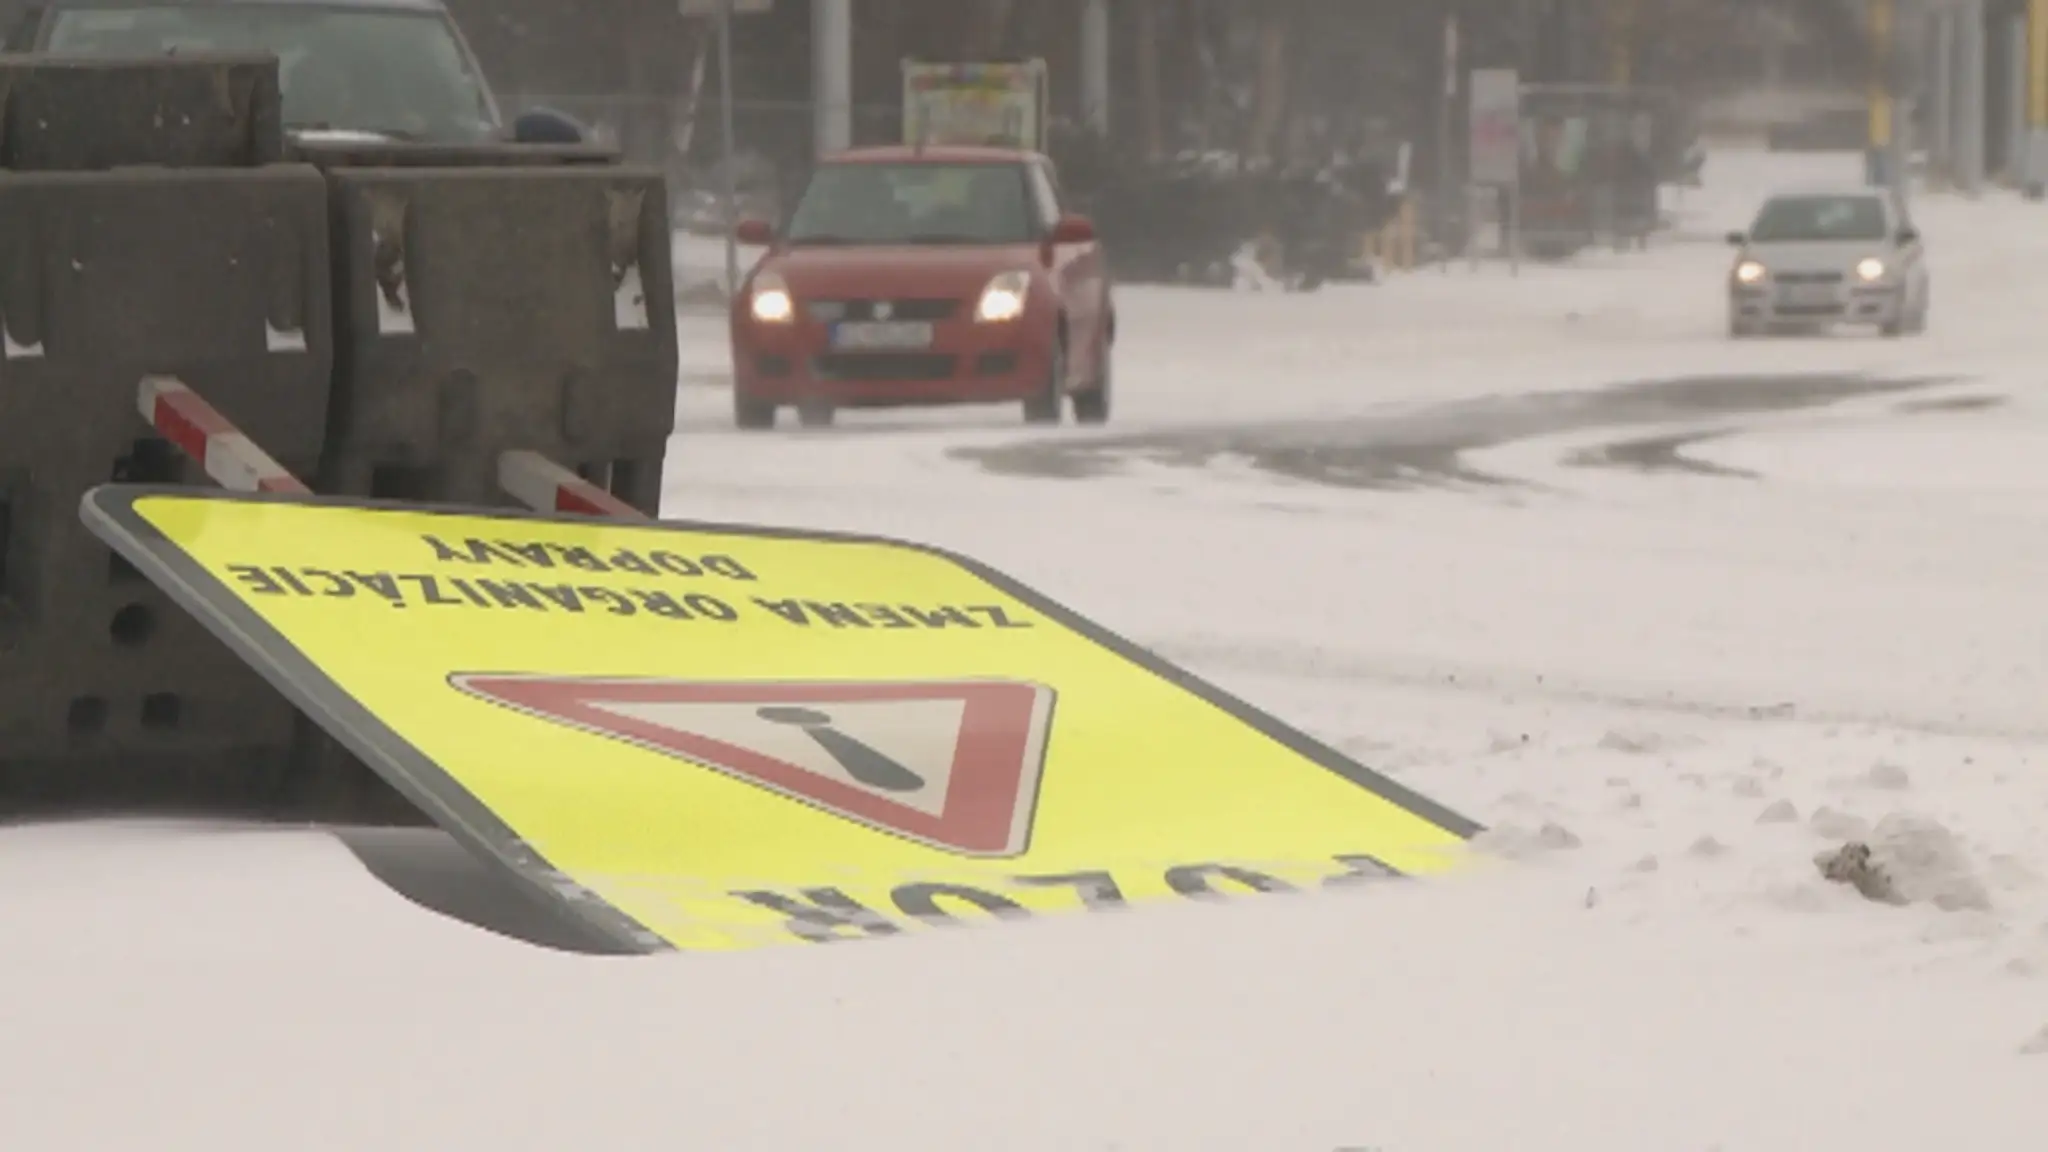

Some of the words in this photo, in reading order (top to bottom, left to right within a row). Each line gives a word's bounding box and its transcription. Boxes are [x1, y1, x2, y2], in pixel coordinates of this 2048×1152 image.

[421, 535, 757, 582] DOPRAVY
[227, 565, 738, 621] ORGANIZÁCIE
[754, 599, 1031, 629] ZMENA
